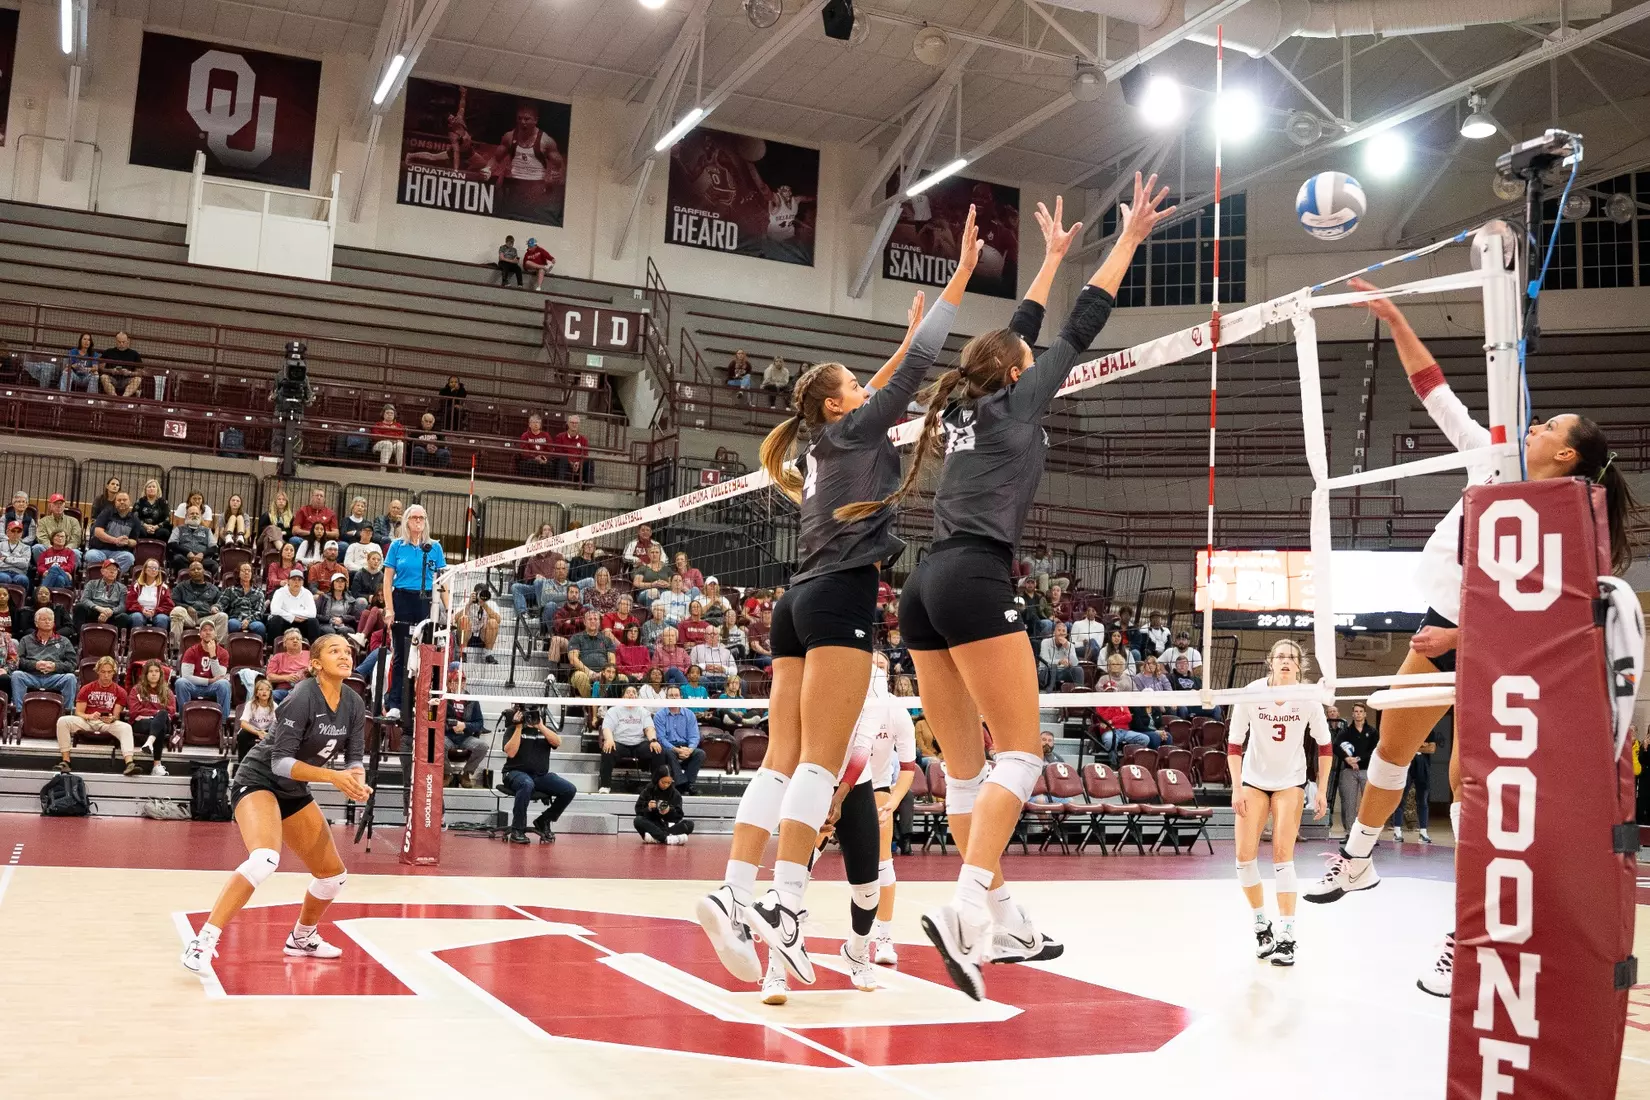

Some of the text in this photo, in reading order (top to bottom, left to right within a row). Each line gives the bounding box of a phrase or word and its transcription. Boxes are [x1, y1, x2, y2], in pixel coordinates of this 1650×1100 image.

[187, 50, 277, 168] OU
[407, 165, 466, 180] JONATHAN
[405, 172, 495, 214] HORTON
[673, 205, 720, 219] GARFIELD
[672, 212, 739, 250] HEARD
[891, 242, 922, 252] ELIANE
[889, 249, 958, 284] SANTOS
[564, 310, 629, 346] C D
[1060, 351, 1136, 390] LLEYBALL
[706, 472, 714, 482] 4
[1477, 498, 1562, 611] OU
[318, 722, 348, 736] Wildcats
[1258, 712, 1301, 722] OKLAHOMA
[1272, 723, 1286, 742] 3
[317, 738, 338, 759] 2
[424, 773, 433, 829] sports imports
